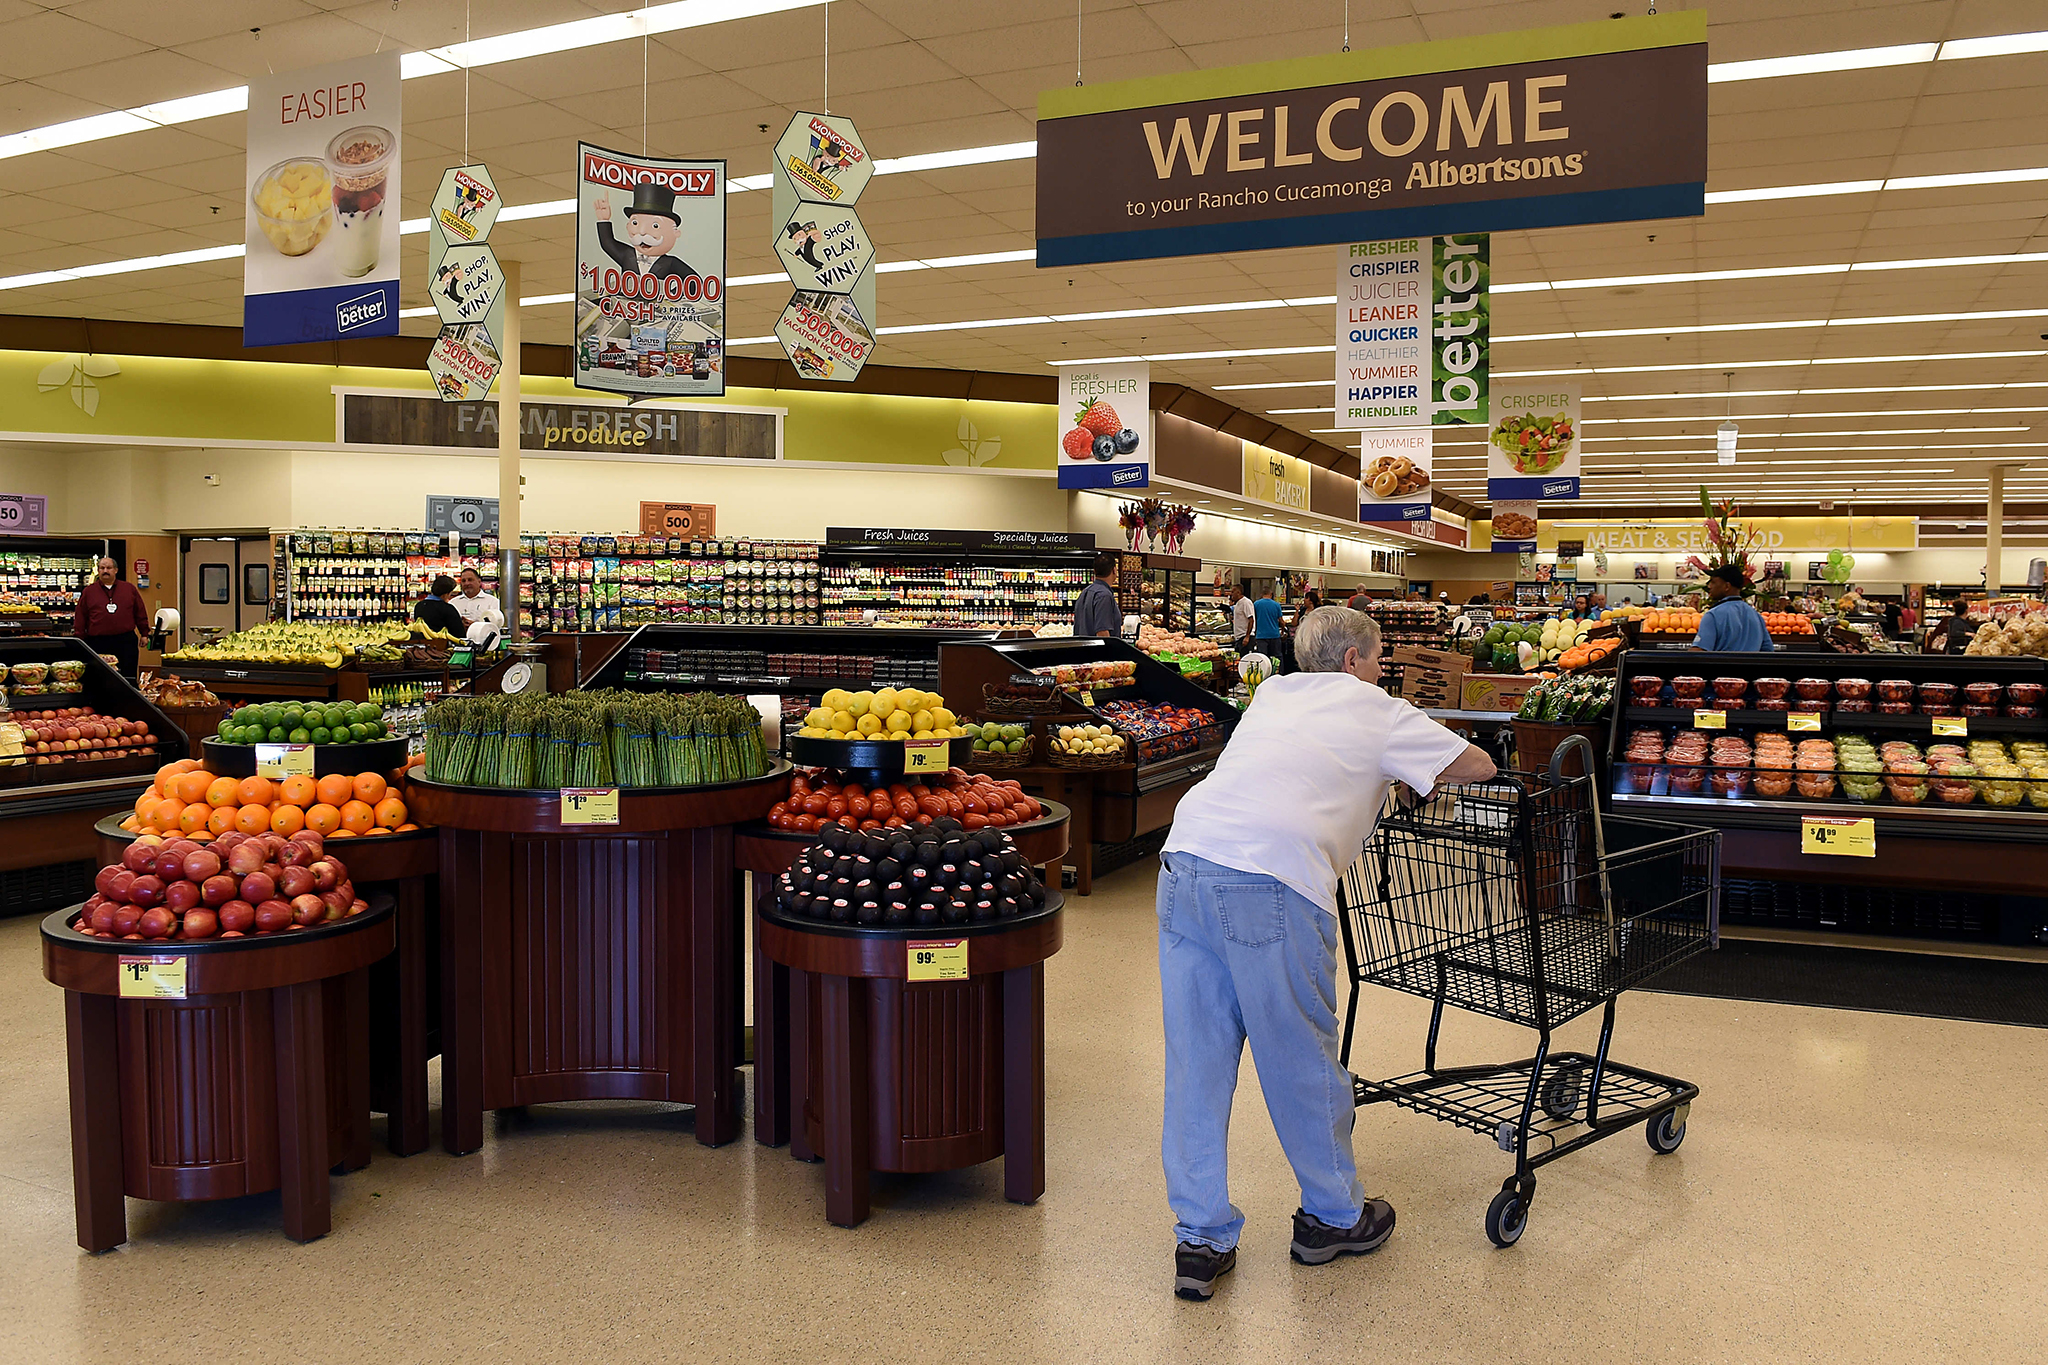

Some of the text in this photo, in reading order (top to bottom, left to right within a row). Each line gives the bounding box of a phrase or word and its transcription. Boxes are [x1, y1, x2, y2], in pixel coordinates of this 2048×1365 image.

[281, 82, 366, 125] EASIER
[1142, 74, 1569, 179] WELCOME
[811, 121, 861, 159] MONOPOLY
[589, 158, 710, 192] MONOPOLY
[1126, 153, 1583, 218] to your Rancho Cucamonga Albertsons
[456, 173, 493, 199] MONOPOLY
[824, 220, 854, 240] SHOP,
[823, 235, 860, 262] PLAY,
[1349, 239, 1419, 257] FRESHER
[464, 255, 488, 276] SHOP,
[815, 259, 858, 288] WIN!
[1350, 260, 1419, 277] CRISPIER
[464, 268, 493, 295] PLAY,
[580, 261, 721, 301] $1,000,000
[1349, 280, 1419, 301] JUICIER
[339, 301, 382, 327] better
[457, 290, 490, 319] WIN!
[1349, 304, 1418, 323] LEANER
[794, 303, 864, 359] $500,000
[1349, 326, 1418, 342] QUICKER
[1432, 236, 1479, 415] better
[783, 316, 843, 361] VACATION HOME
[441, 336, 493, 380] $500,000
[601, 352, 626, 361] BRAWNY
[1348, 347, 1418, 361] HEALTHIER
[432, 349, 477, 383] VACATION HOME
[1349, 364, 1418, 380] YUMMIER
[1070, 373, 1091, 381] Local
[1070, 379, 1137, 395] FRESHER
[1349, 385, 1418, 400] HAPPIER
[1501, 394, 1569, 408] CRISPIER
[1348, 405, 1418, 418] FRIENDLIER
[457, 404, 678, 441] FAM FRESH
[543, 423, 647, 448] produce
[1368, 437, 1425, 450] YUMMIER
[1114, 471, 1140, 482] better
[1269, 456, 1285, 478] fresh
[1275, 478, 1306, 508] BAKERY
[1545, 483, 1571, 495] better
[0, 507, 18, 520] 50
[459, 510, 475, 523] 10
[666, 516, 690, 528] 500
[864, 529, 930, 541] Fresh Juices
[993, 532, 1068, 545] Specialty Juices
[1587, 531, 1647, 548] MEAT
[1653, 531, 1670, 548] &
